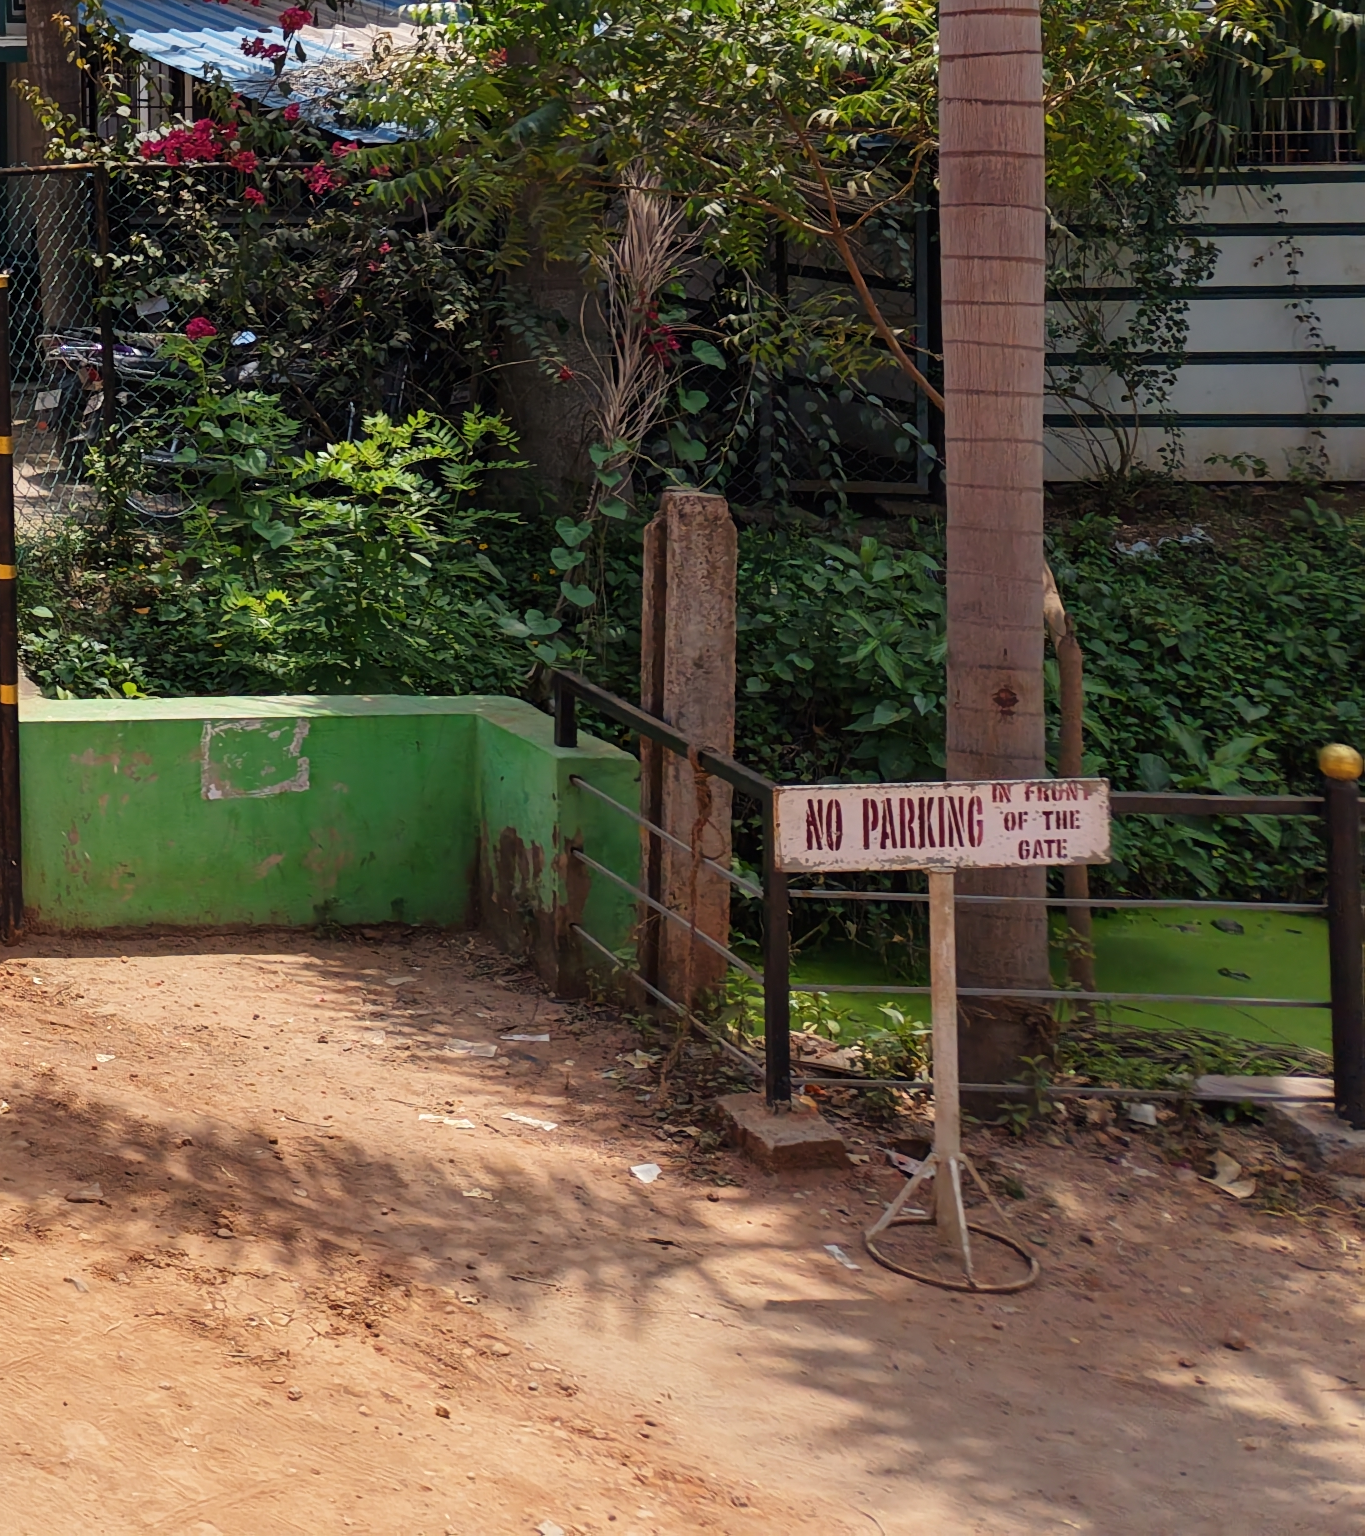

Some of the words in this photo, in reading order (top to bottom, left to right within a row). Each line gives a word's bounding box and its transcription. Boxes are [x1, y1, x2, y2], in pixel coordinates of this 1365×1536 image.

[991, 783, 1011, 804] IN
[1024, 782, 1091, 802] FRONT
[806, 798, 843, 851] NO
[862, 795, 984, 850] PARKING
[1003, 810, 1028, 832] OF
[1042, 809, 1081, 831] THE
[1018, 838, 1068, 860] GATE
